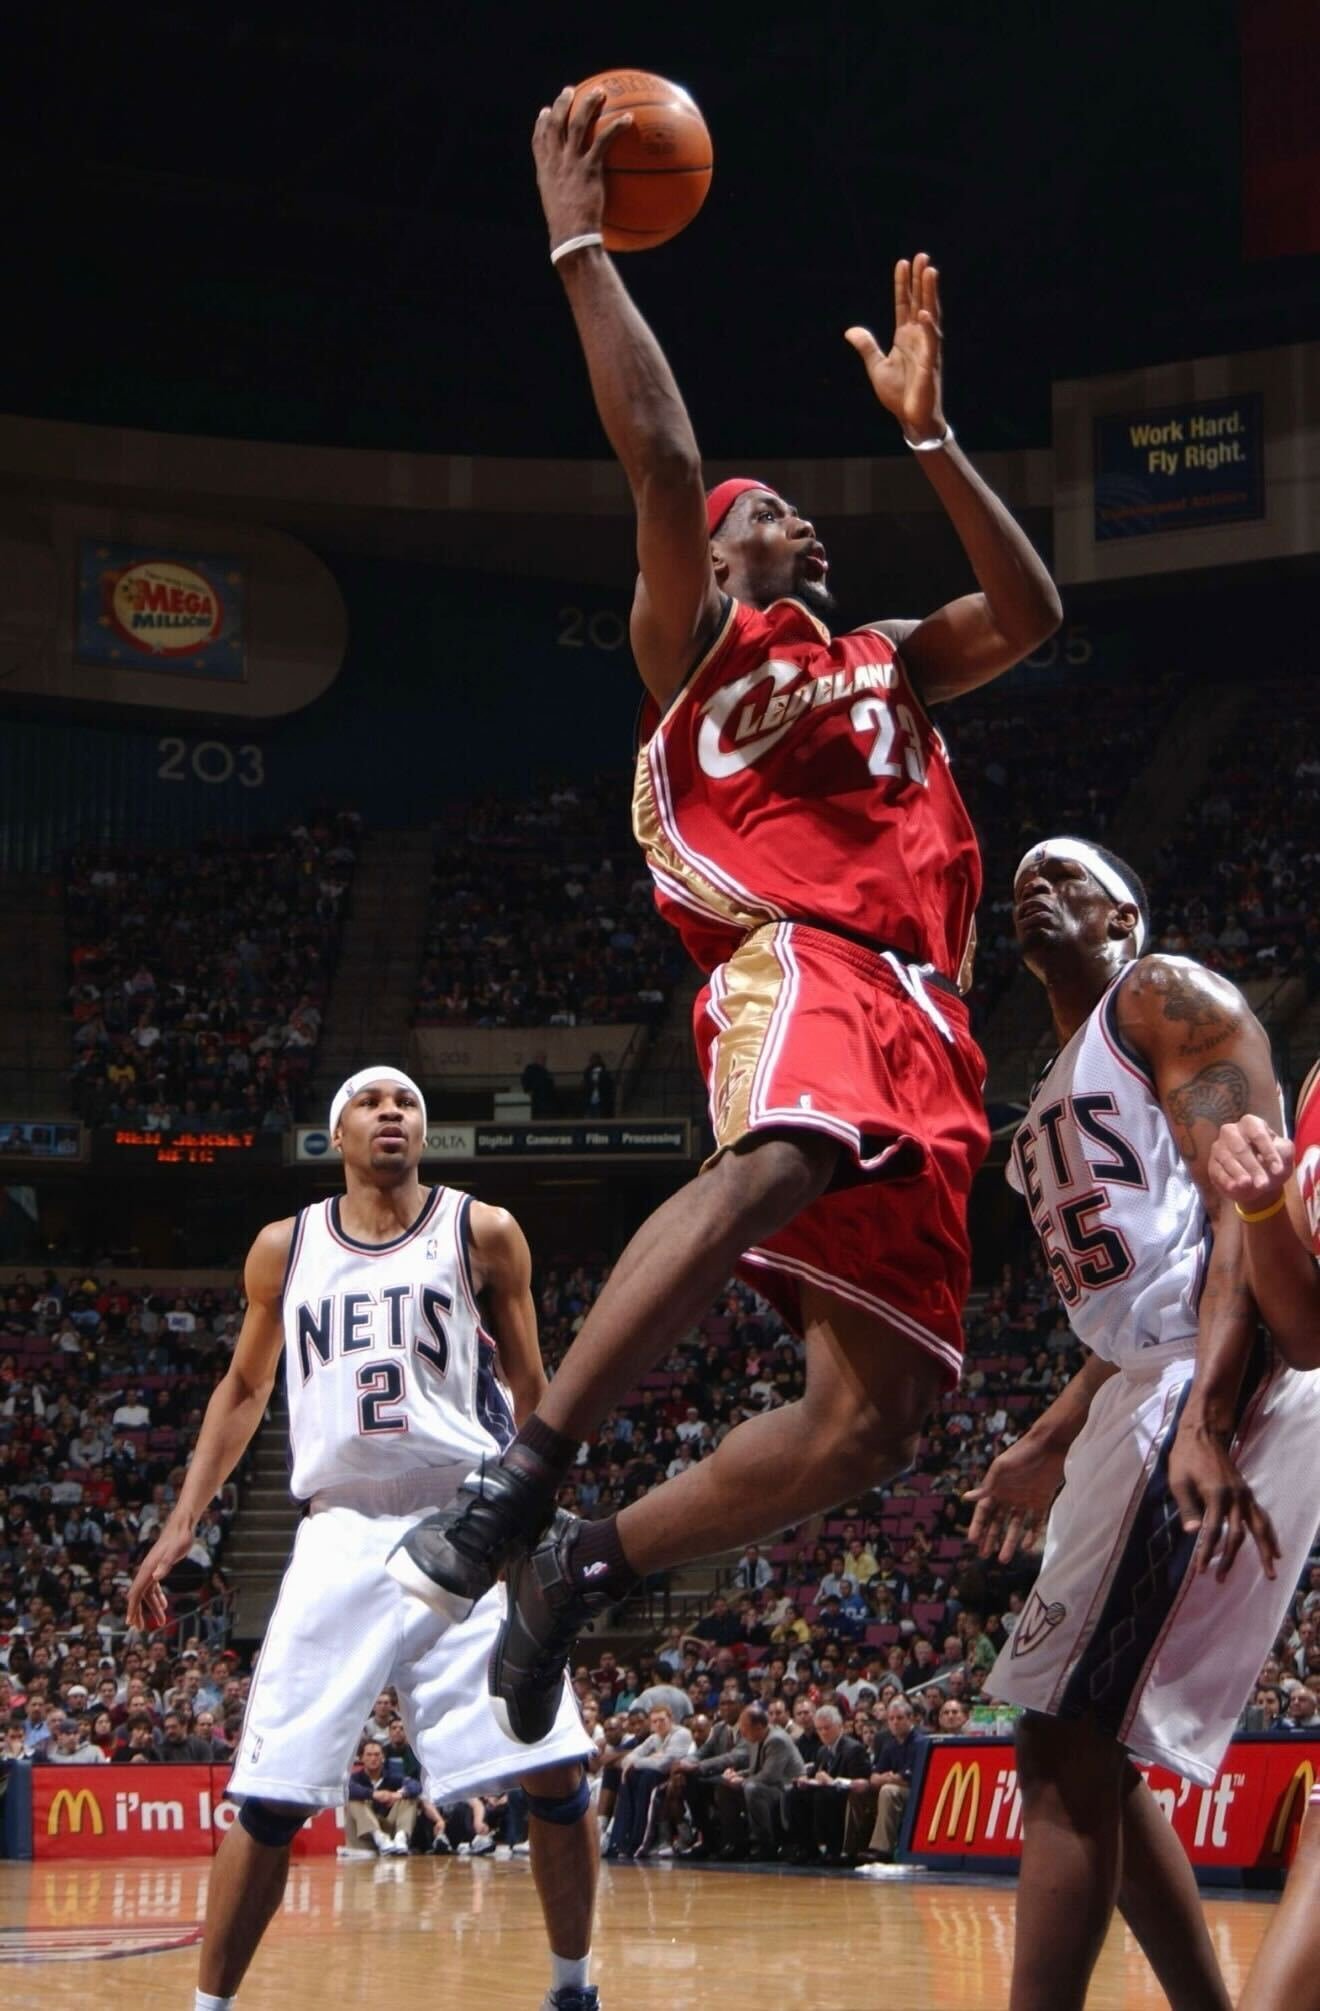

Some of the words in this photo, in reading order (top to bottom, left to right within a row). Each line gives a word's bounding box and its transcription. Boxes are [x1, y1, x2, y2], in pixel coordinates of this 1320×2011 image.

[1129, 420, 1183, 448] Work
[1190, 410, 1245, 438] Hard.
[1148, 450, 1179, 476] Fly
[1185, 440, 1245, 470] Right.
[134, 579, 212, 615] MEGA
[557, 606, 626, 651] 20
[157, 737, 265, 788] 203
[850, 697, 928, 787] 23
[427, 1135, 467, 1150] OLTA
[478, 1134, 514, 1149] Digital
[585, 1133, 610, 1145] Film
[621, 1132, 681, 1147] Processing
[1012, 1091, 1149, 1218] ETS
[296, 1283, 455, 1387] NETS
[356, 1358, 409, 1435] 2
[115, 1792, 184, 1831] i'm
